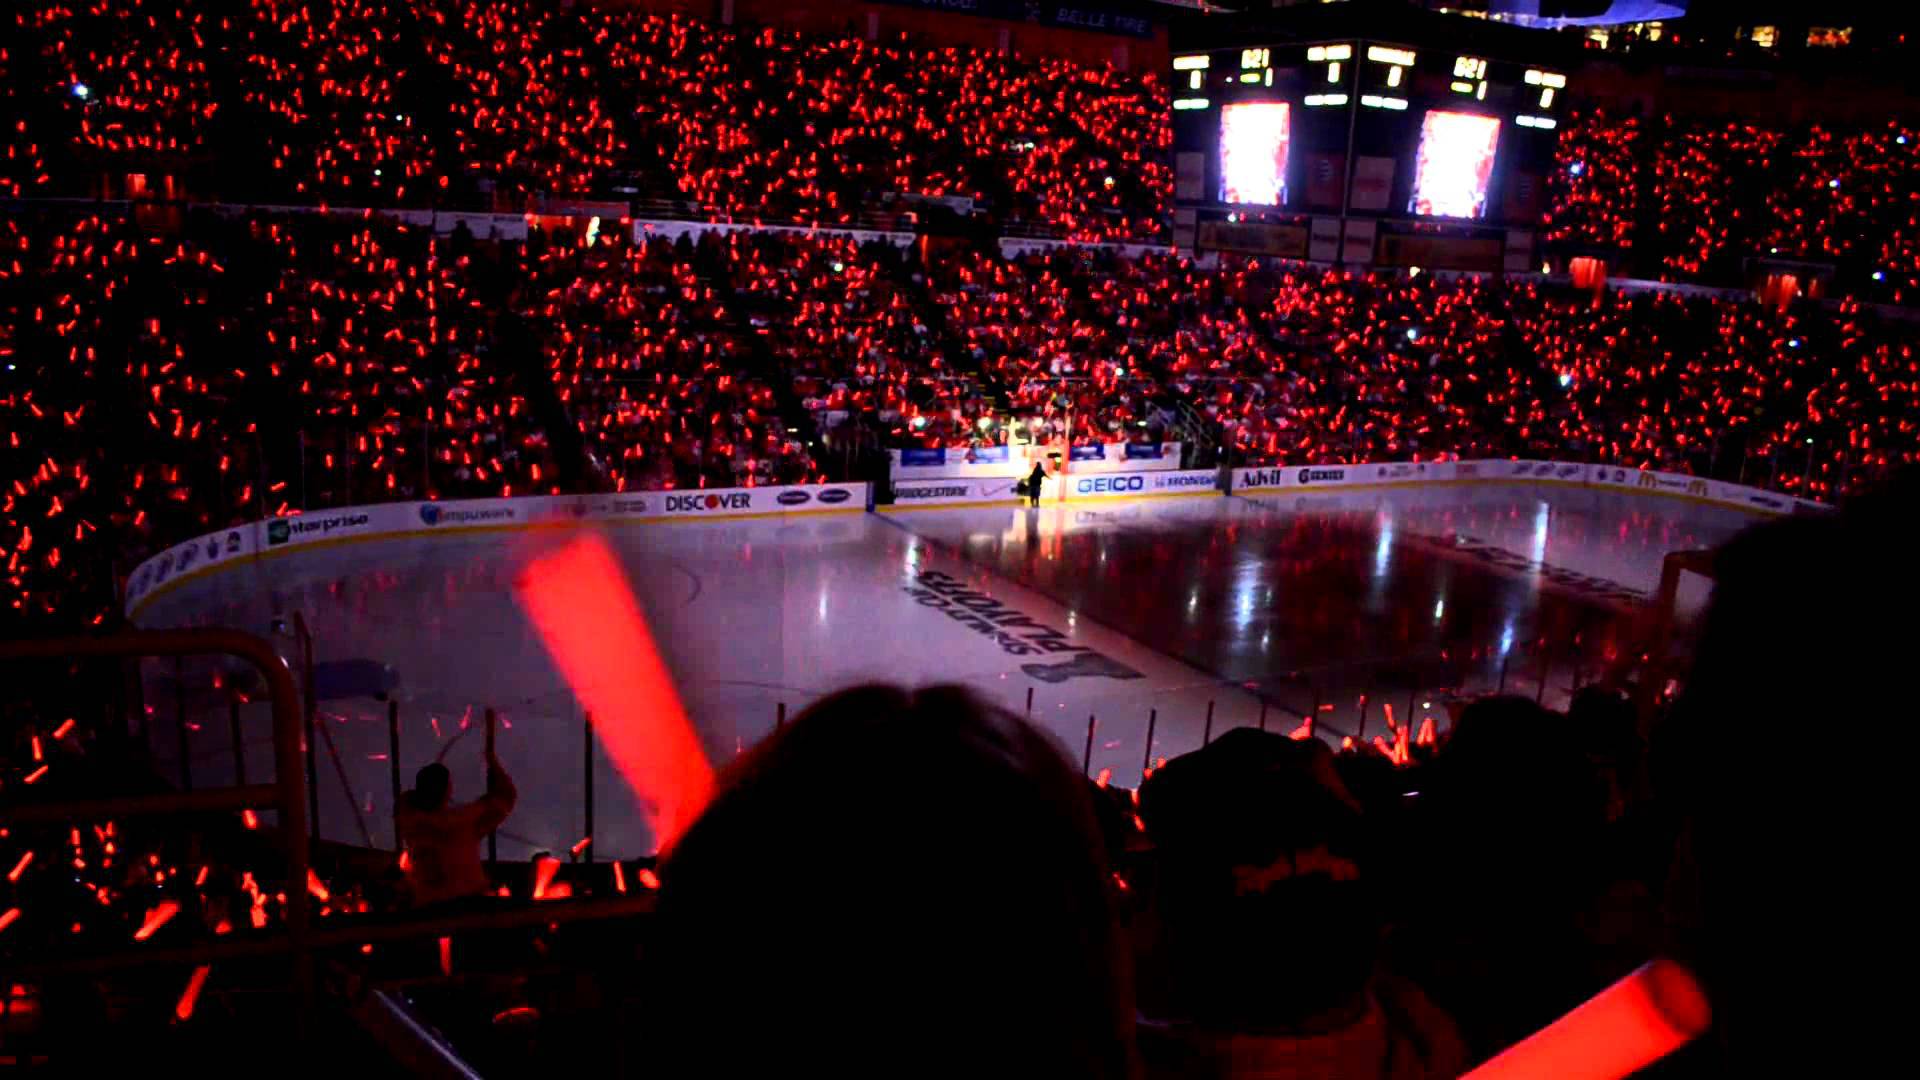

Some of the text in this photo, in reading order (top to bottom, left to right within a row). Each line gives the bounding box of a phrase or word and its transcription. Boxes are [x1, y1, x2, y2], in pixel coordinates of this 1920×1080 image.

[1056, 8, 1105, 28] BELLE
[1077, 476, 1144, 493] GEICO
[1240, 469, 1281, 487] Advil
[665, 492, 751, 512] DISCOVER
[914, 570, 1094, 655] PLAYOFFS
